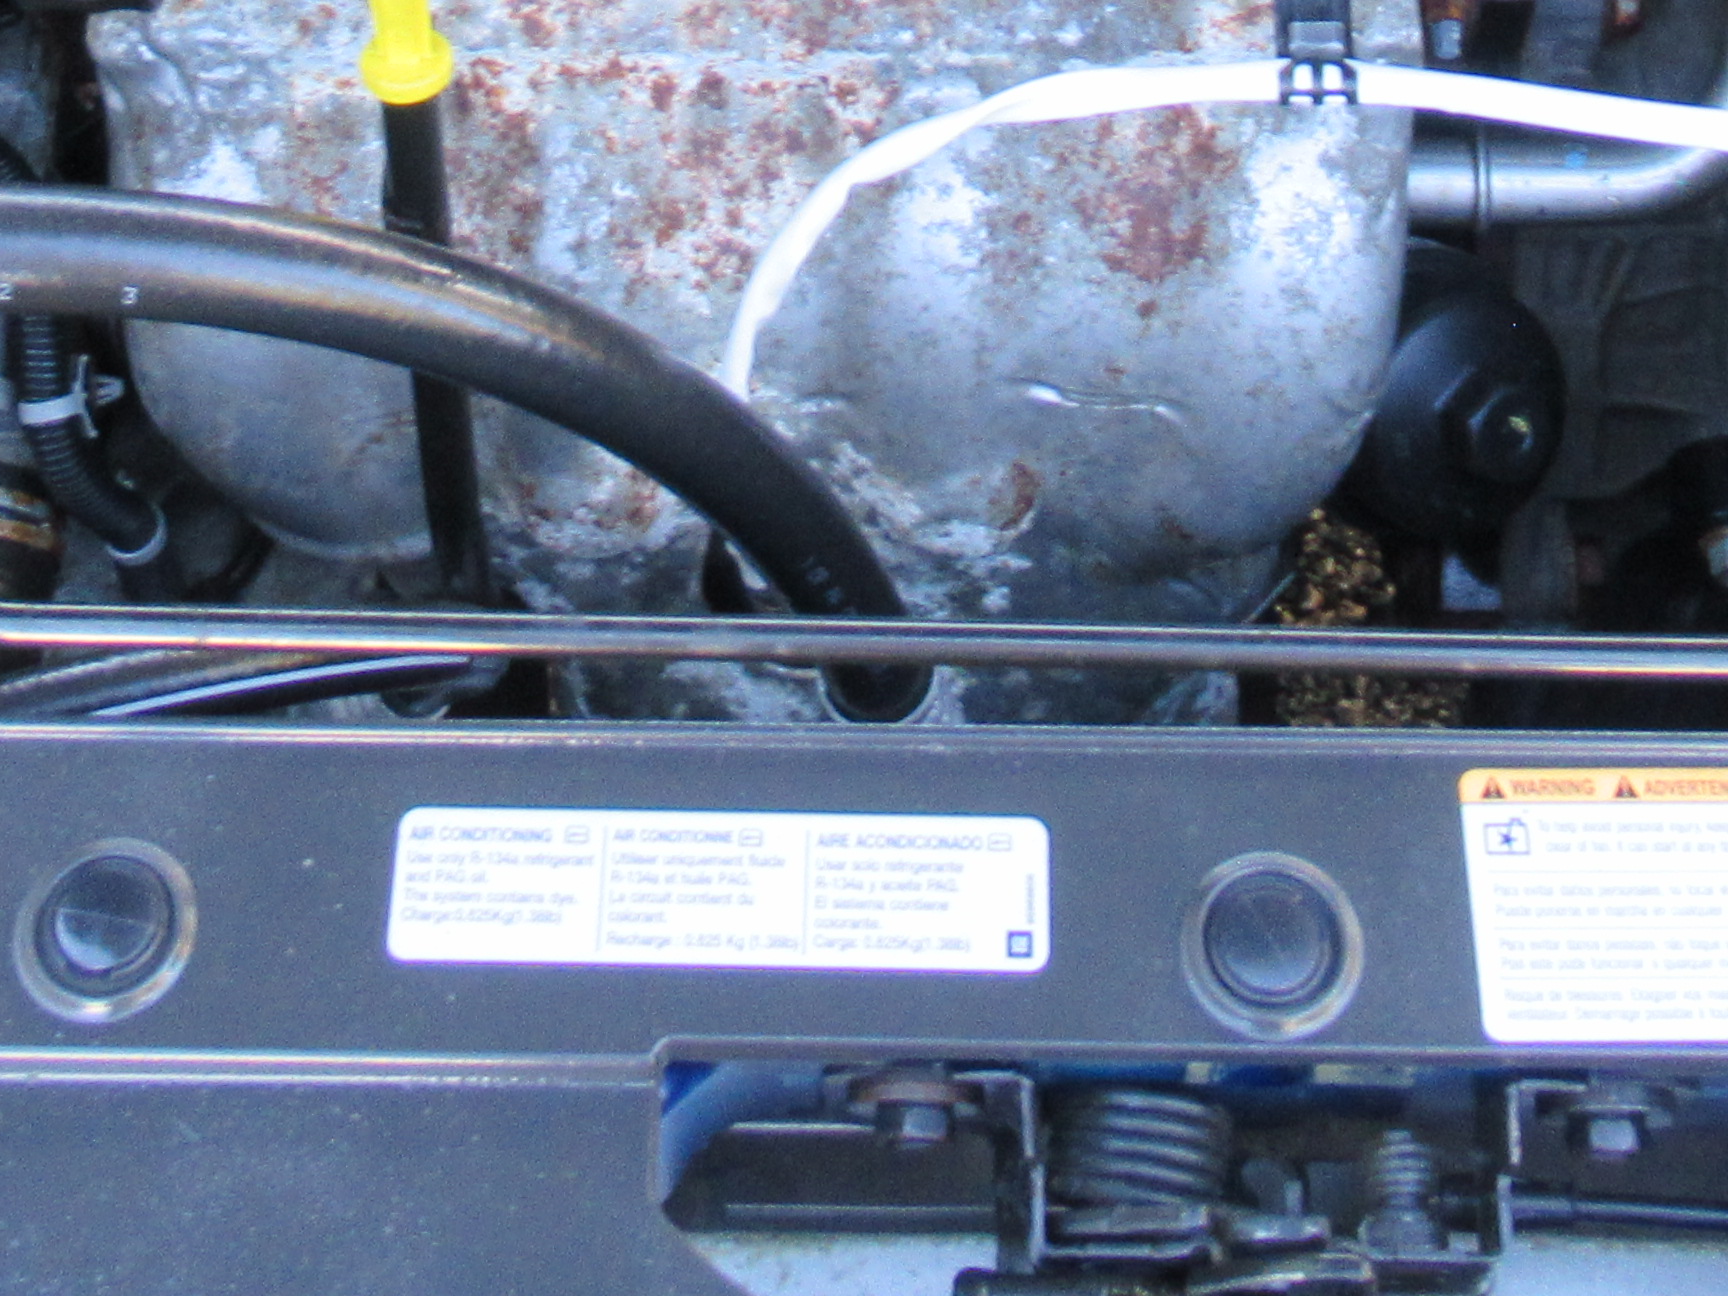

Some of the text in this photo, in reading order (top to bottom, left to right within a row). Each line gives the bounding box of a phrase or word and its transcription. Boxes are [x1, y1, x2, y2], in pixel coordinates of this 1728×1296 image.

[1510, 779, 1596, 797] WARNING
[438, 826, 553, 843] CONDITIONING
[854, 833, 984, 851] ACONDICIONADO
